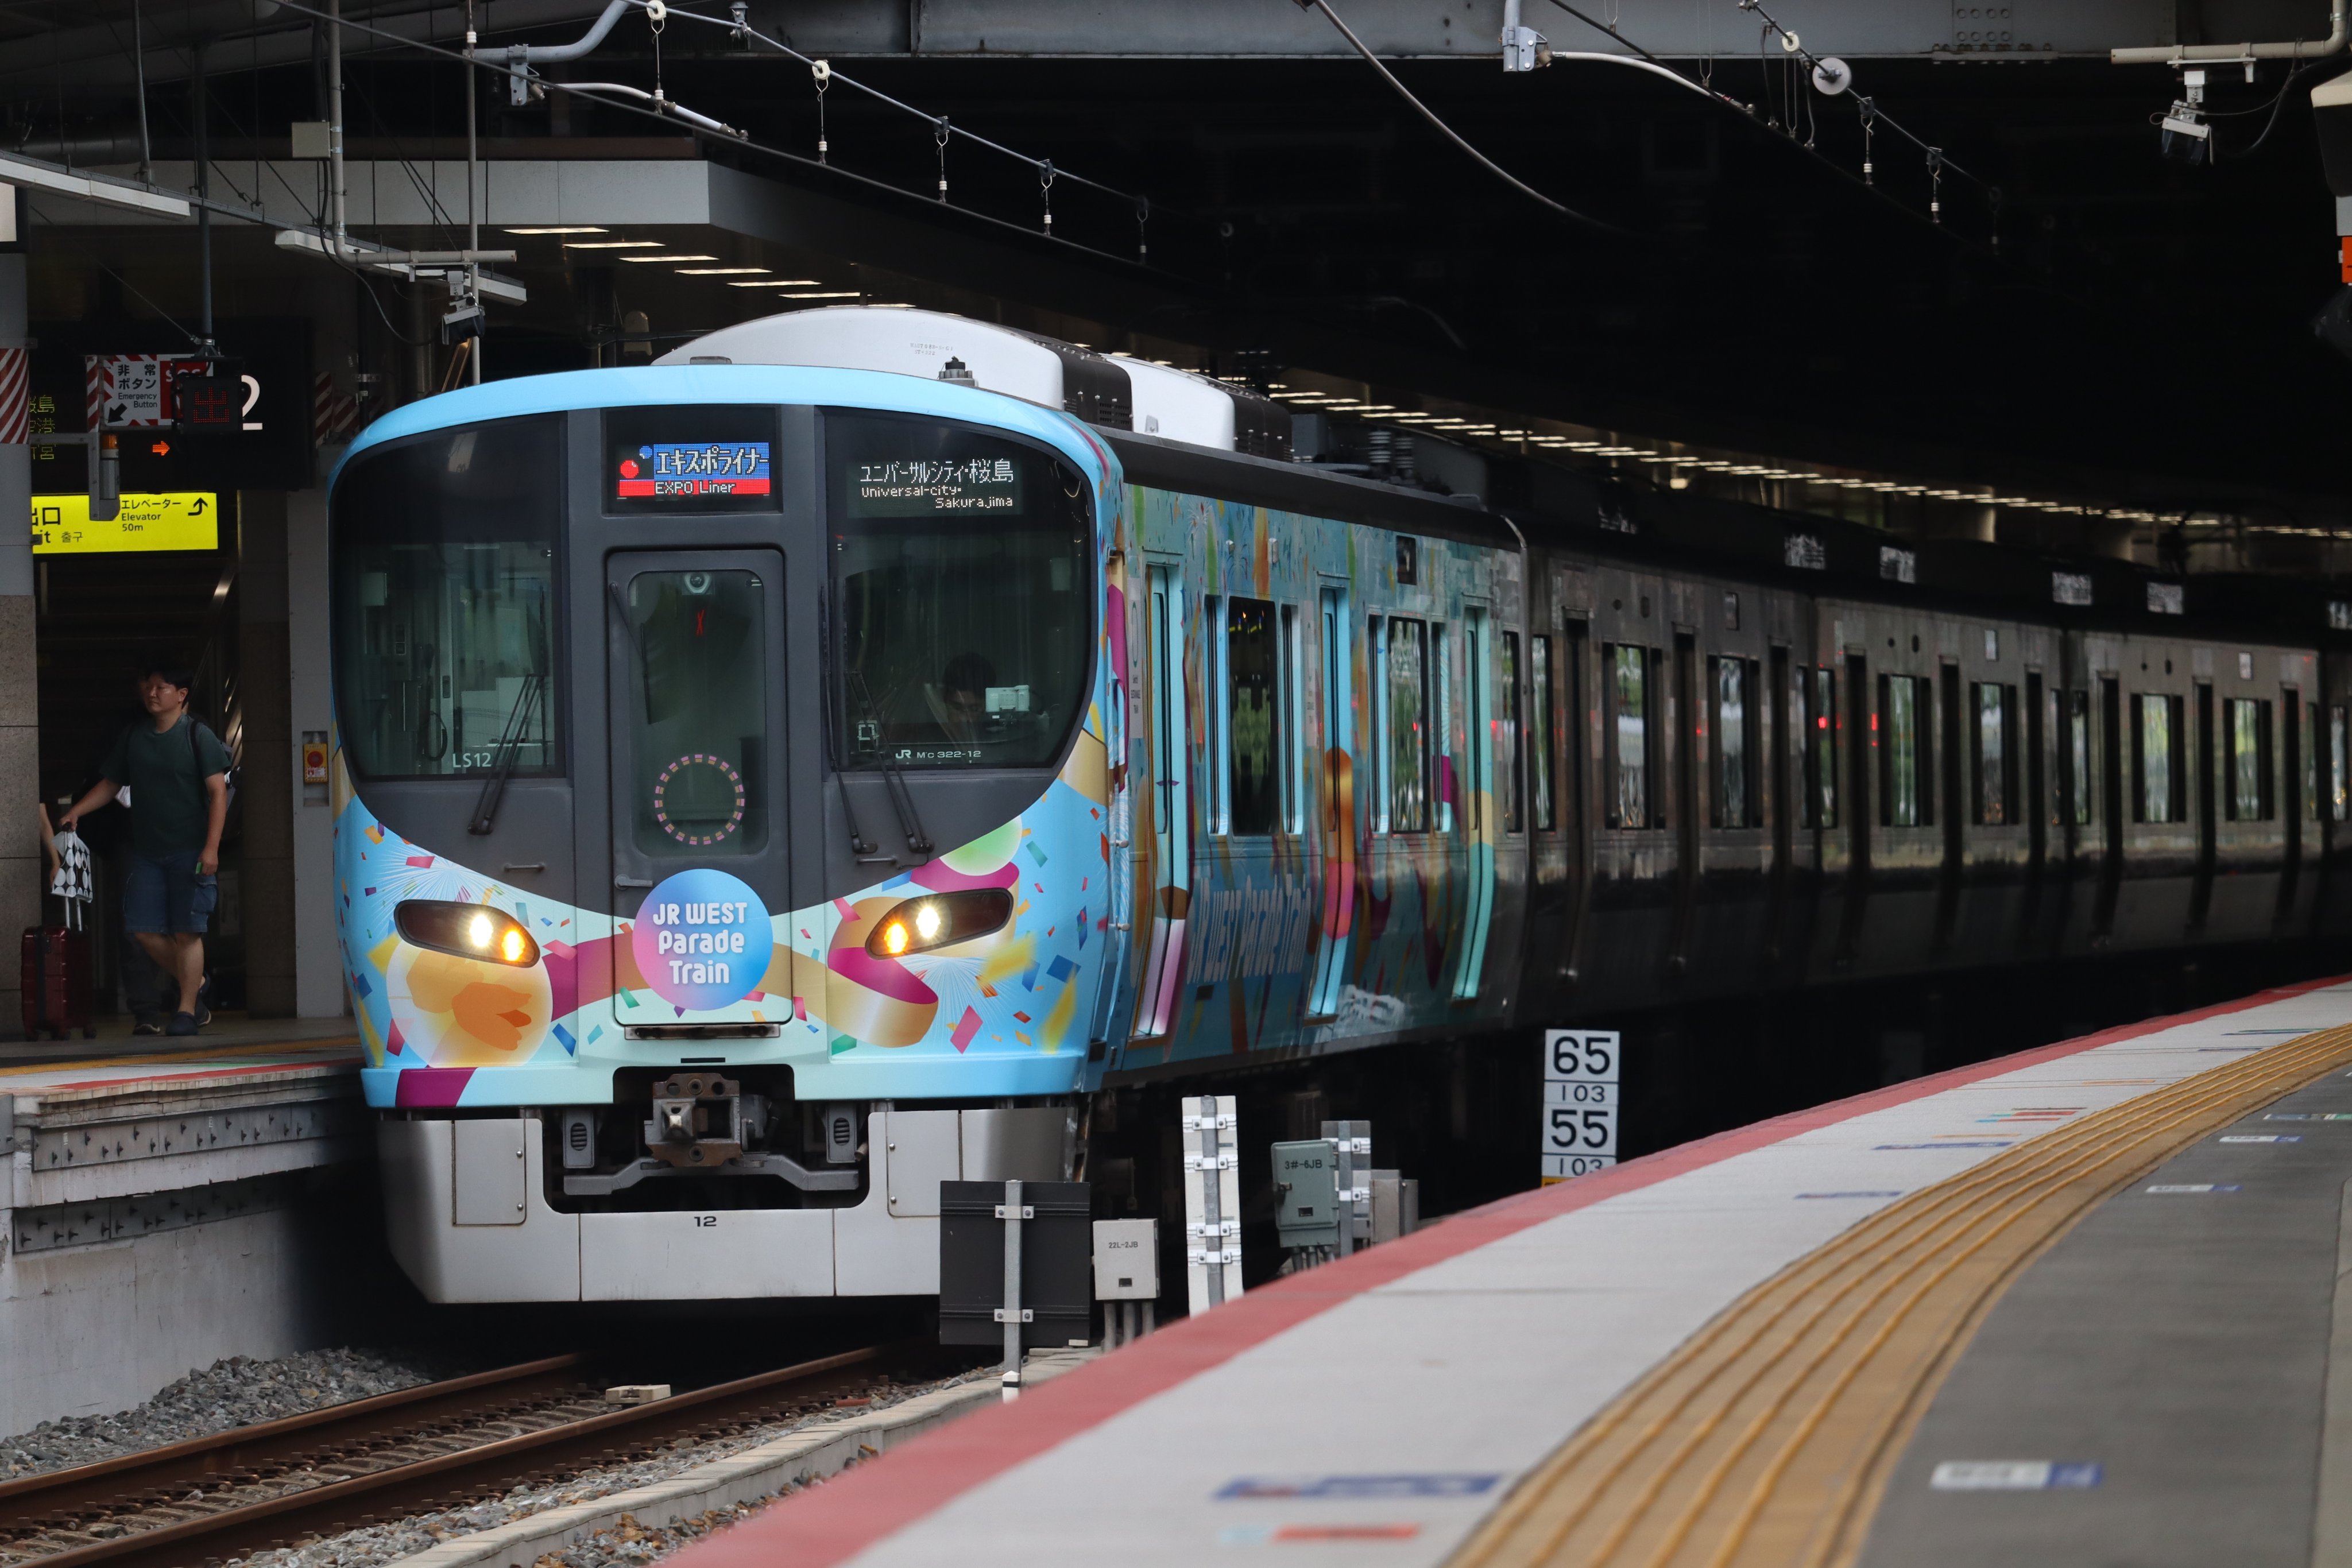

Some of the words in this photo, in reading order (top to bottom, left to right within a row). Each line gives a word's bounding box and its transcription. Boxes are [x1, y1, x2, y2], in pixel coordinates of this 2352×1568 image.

[118, 364, 156, 376] 非常
[119, 378, 156, 390] ボタン
[118, 393, 157, 401] Emergency
[193, 386, 230, 423] 出
[656, 446, 768, 475] エキスポライナー
[655, 481, 693, 494] EXPO
[699, 481, 735, 494] Liner
[121, 498, 181, 510] エレベーター
[935, 497, 1013, 508] Sakurajima
[121, 513, 161, 521] Elevator
[122, 523, 144, 532] 50m
[61, 532, 83, 543] 출구
[895, 749, 911, 759] JR
[452, 753, 492, 768] LS12
[652, 903, 680, 926] JR
[686, 902, 748, 924] WEST
[658, 929, 745, 955] Parade
[669, 960, 729, 984] Train
[1553, 1036, 1611, 1075] 65
[1561, 1085, 1605, 1102] 103
[1551, 1109, 1609, 1148] 55
[694, 1215, 717, 1227] 12
